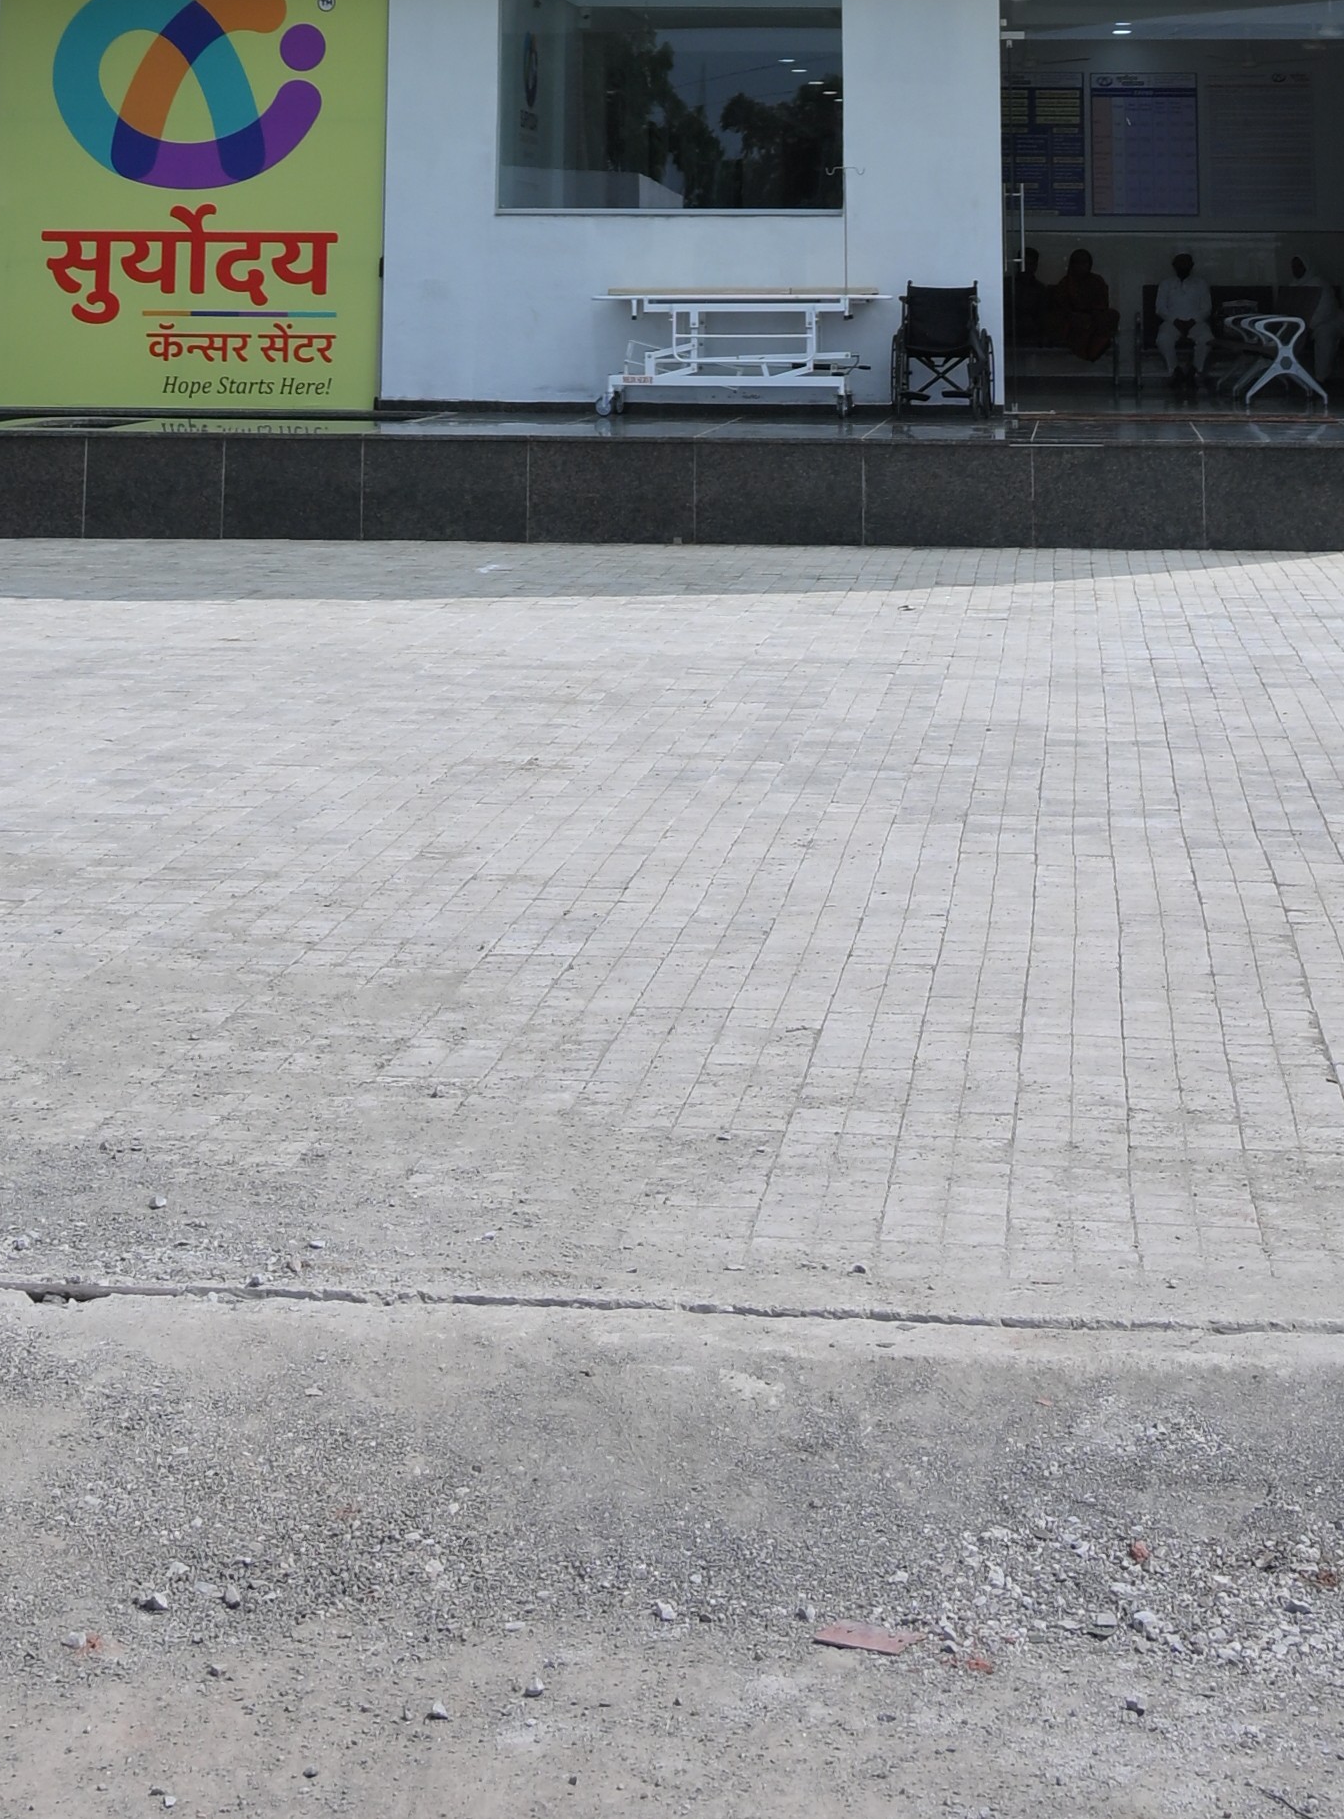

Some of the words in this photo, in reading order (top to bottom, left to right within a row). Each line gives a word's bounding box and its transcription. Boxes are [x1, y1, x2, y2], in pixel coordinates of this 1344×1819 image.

[41, 202, 338, 324] सुर्योदय
[146, 322, 252, 363] कॅन्सर
[258, 322, 336, 363] सेंटर
[162, 375, 212, 399] Hope
[217, 376, 275, 395] Starts
[279, 377, 332, 395] Here!
